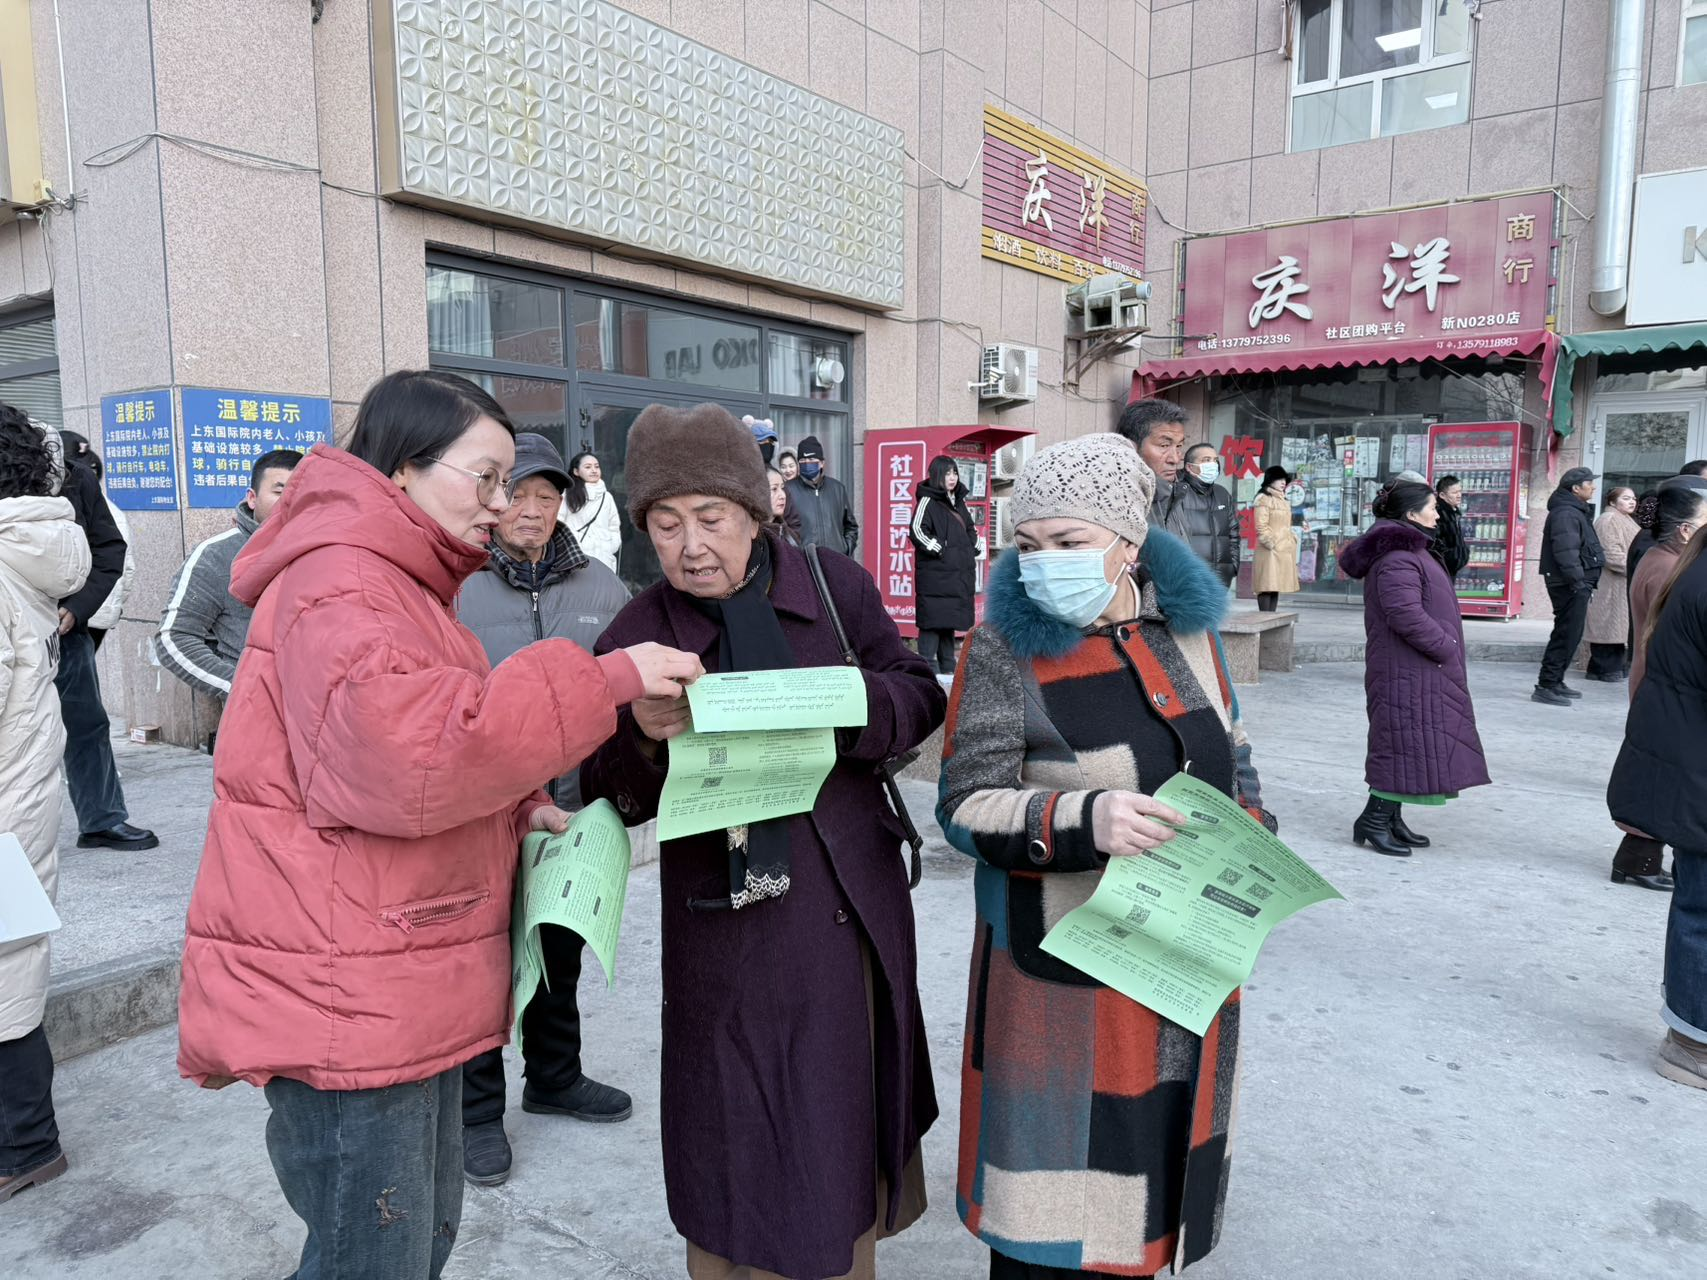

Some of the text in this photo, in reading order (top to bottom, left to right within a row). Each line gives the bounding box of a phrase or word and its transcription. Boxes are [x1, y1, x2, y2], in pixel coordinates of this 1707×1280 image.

[1130, 192, 1142, 244] 商行
[992, 232, 1022, 259] 烟酒
[1034, 246, 1062, 272] 饮料
[1503, 212, 1536, 285] 商行
[1249, 236, 1461, 328] 庆洋
[1325, 320, 1406, 340] 社区团购平台
[115, 399, 156, 424] 温馨提示
[217, 398, 301, 424] 温馨提示
[191, 424, 326, 443] 上东国际院内老人、小孩及
[192, 457, 256, 472] 球，骑行自
[889, 454, 914, 597] 社区直饮水站
